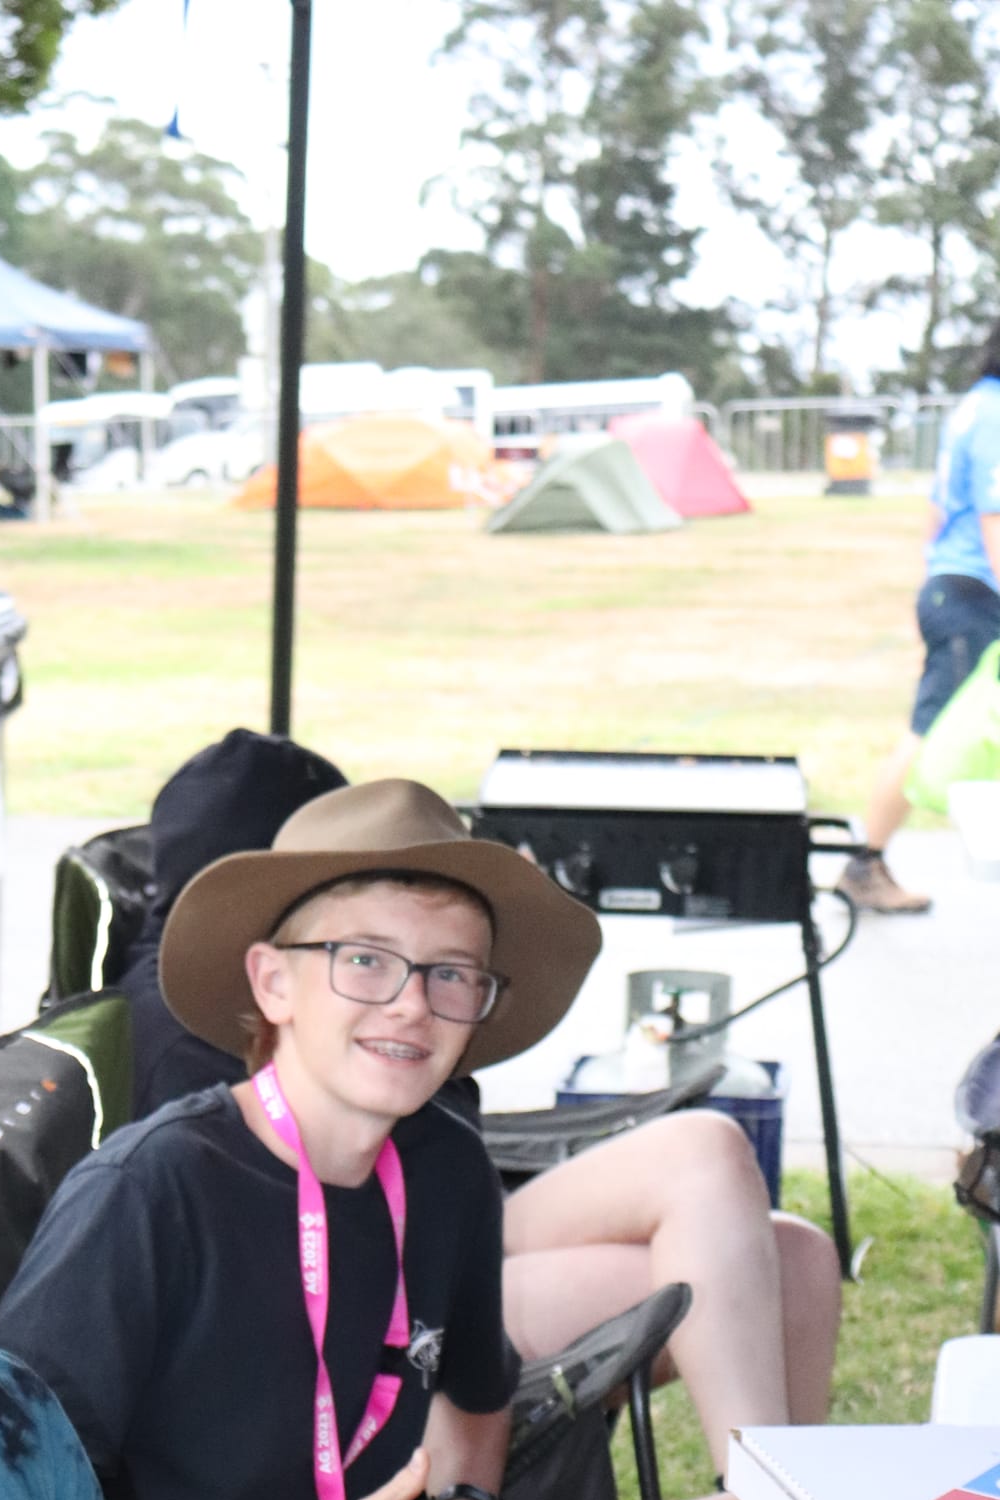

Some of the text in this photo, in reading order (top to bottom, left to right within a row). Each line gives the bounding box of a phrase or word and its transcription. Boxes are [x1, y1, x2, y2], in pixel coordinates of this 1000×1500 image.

[302, 1229, 318, 1296] AG 2023
[318, 1451, 333, 1474] AG
